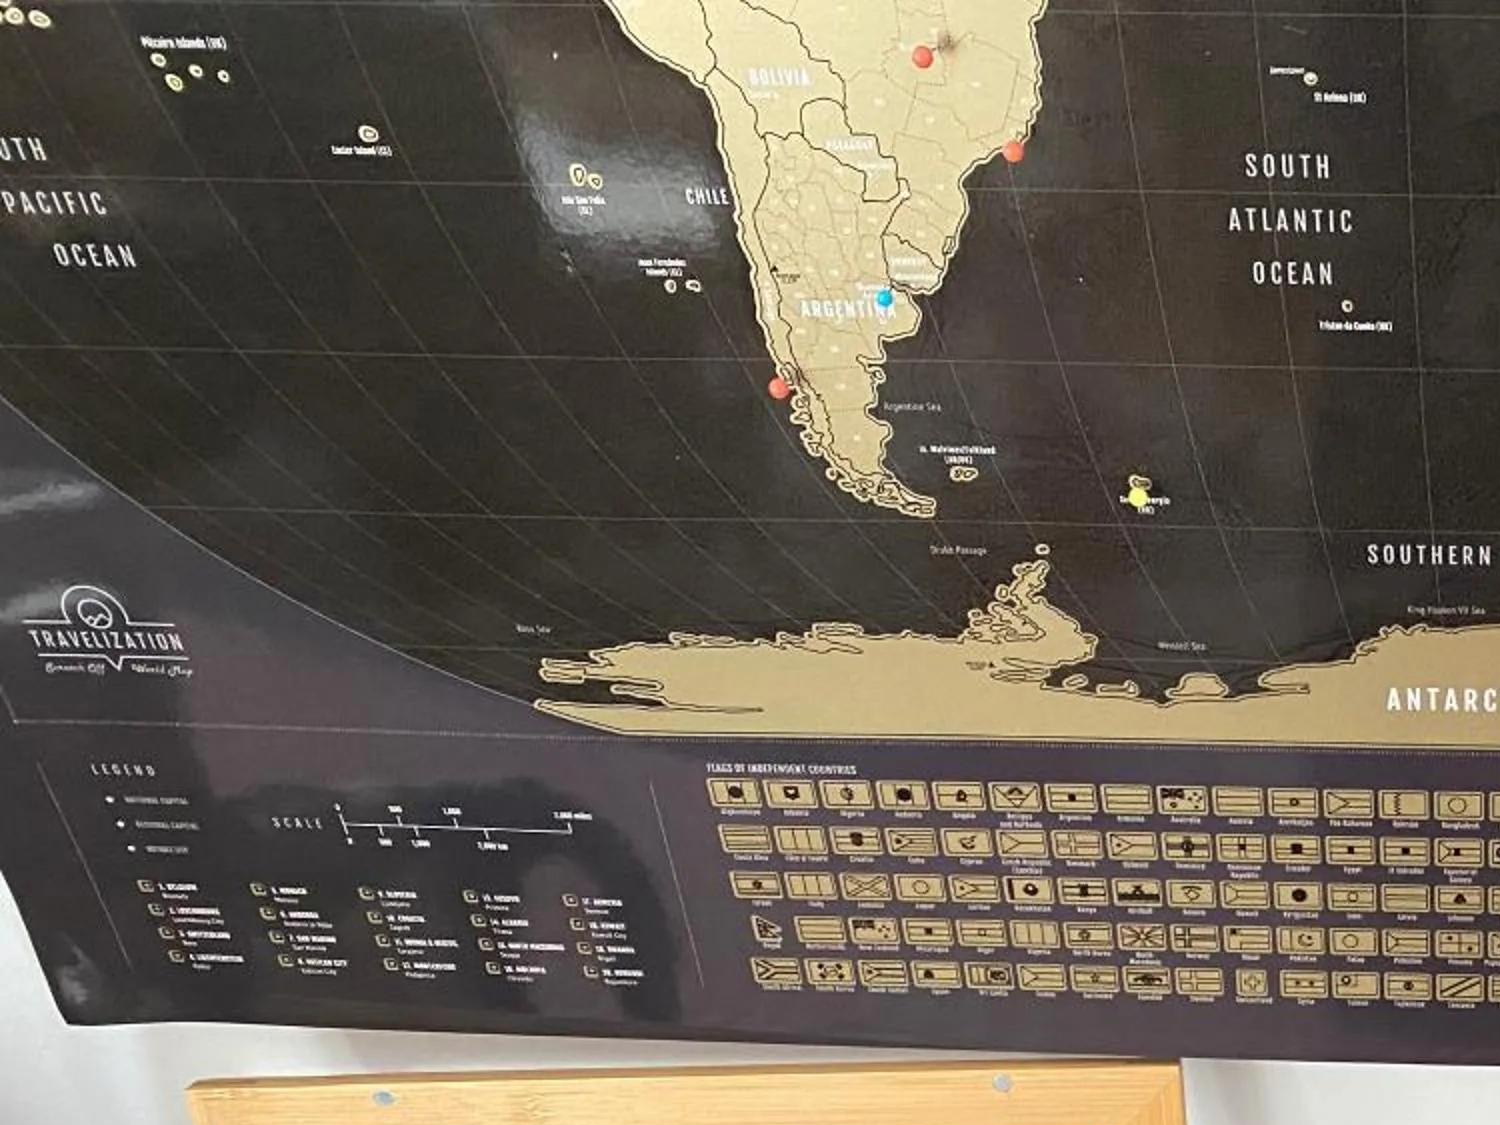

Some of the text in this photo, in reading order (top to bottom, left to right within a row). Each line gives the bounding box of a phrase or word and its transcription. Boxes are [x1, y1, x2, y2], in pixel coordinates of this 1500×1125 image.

[748, 68, 810, 86] BOLIVIA
[1245, 153, 1331, 180] SOUTH
[3, 191, 108, 216] PACIFIC
[685, 187, 731, 205] CHILE
[1228, 207, 1354, 234] ATLANTIC
[53, 243, 137, 268] OCEAN
[1252, 261, 1334, 286] OCEAN
[800, 300, 898, 320] ARGENTINA
[1366, 541, 1494, 566] SOUTHERN
[28, 629, 184, 651] TRAVELIZATION
[91, 763, 156, 777] LEGEND
[271, 816, 323, 830] SCALE
